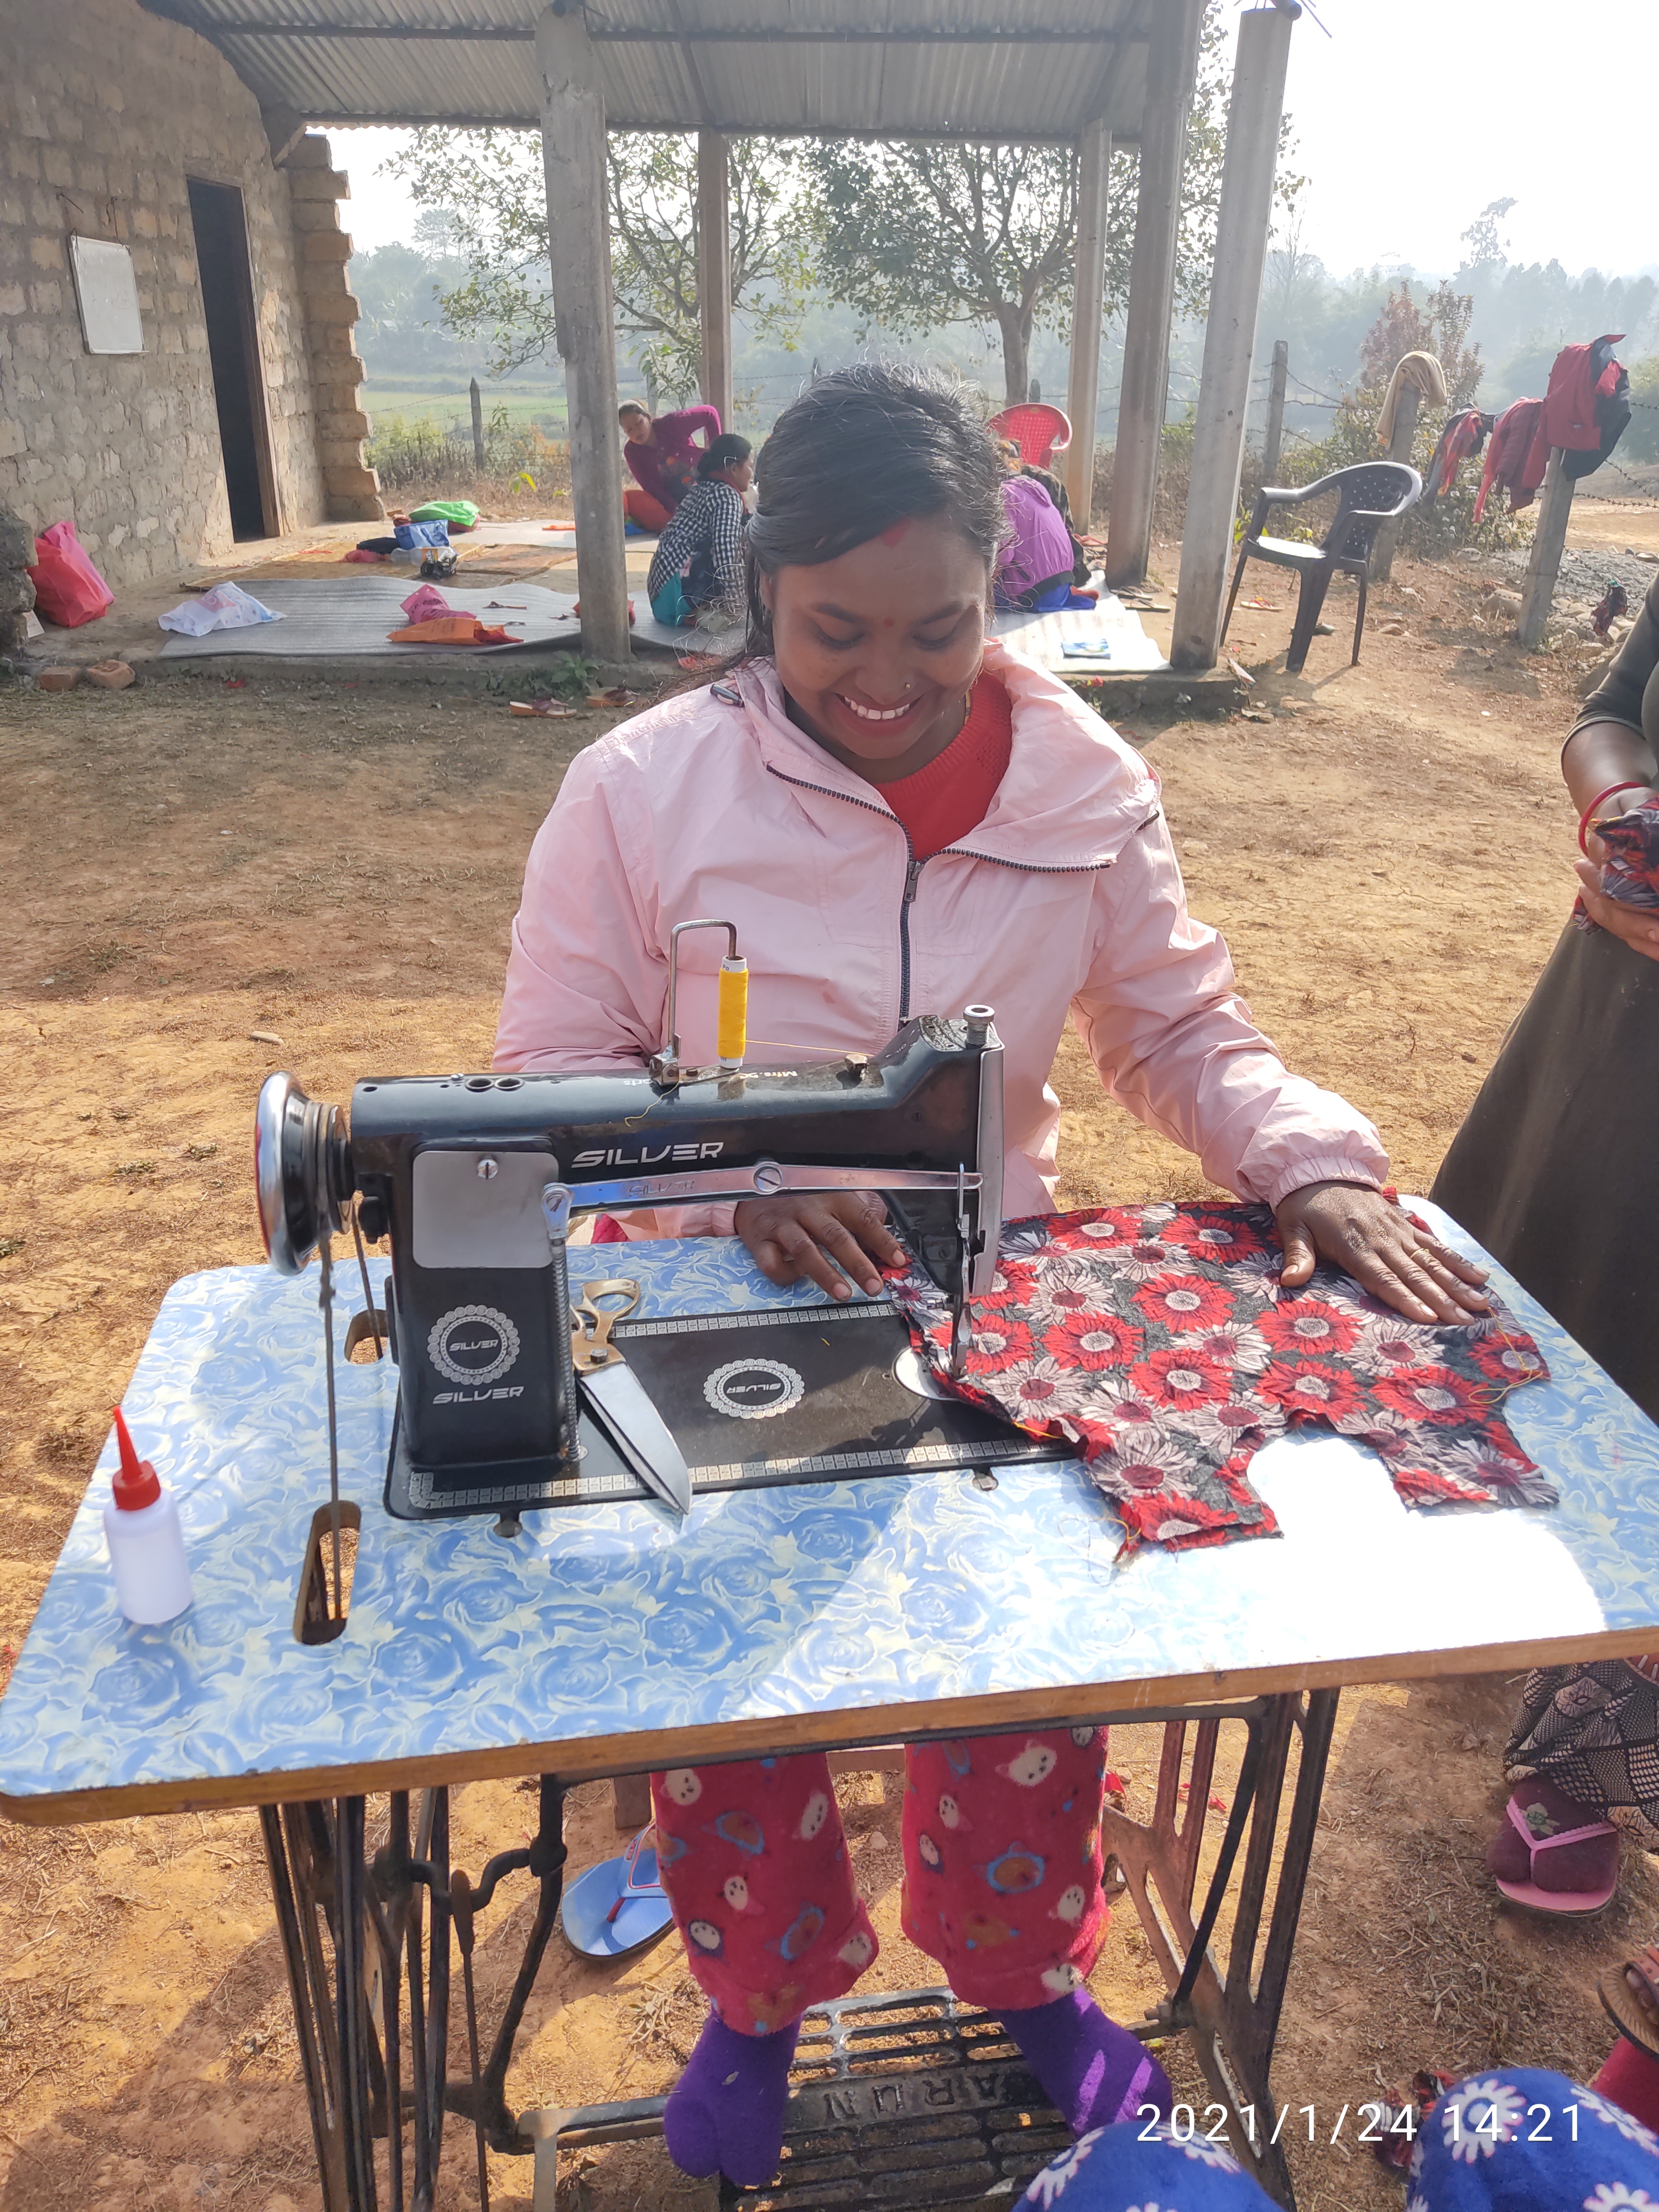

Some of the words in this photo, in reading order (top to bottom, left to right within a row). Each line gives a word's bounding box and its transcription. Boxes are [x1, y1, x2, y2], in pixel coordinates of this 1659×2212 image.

[571, 1141, 724, 1168] SILVER
[628, 1179, 696, 1197] SILVER
[449, 1339, 499, 1352] SILVER
[432, 1386, 525, 1405] SILVER
[726, 1383, 781, 1394] SILVER
[823, 2073, 1006, 2120] ARUN
